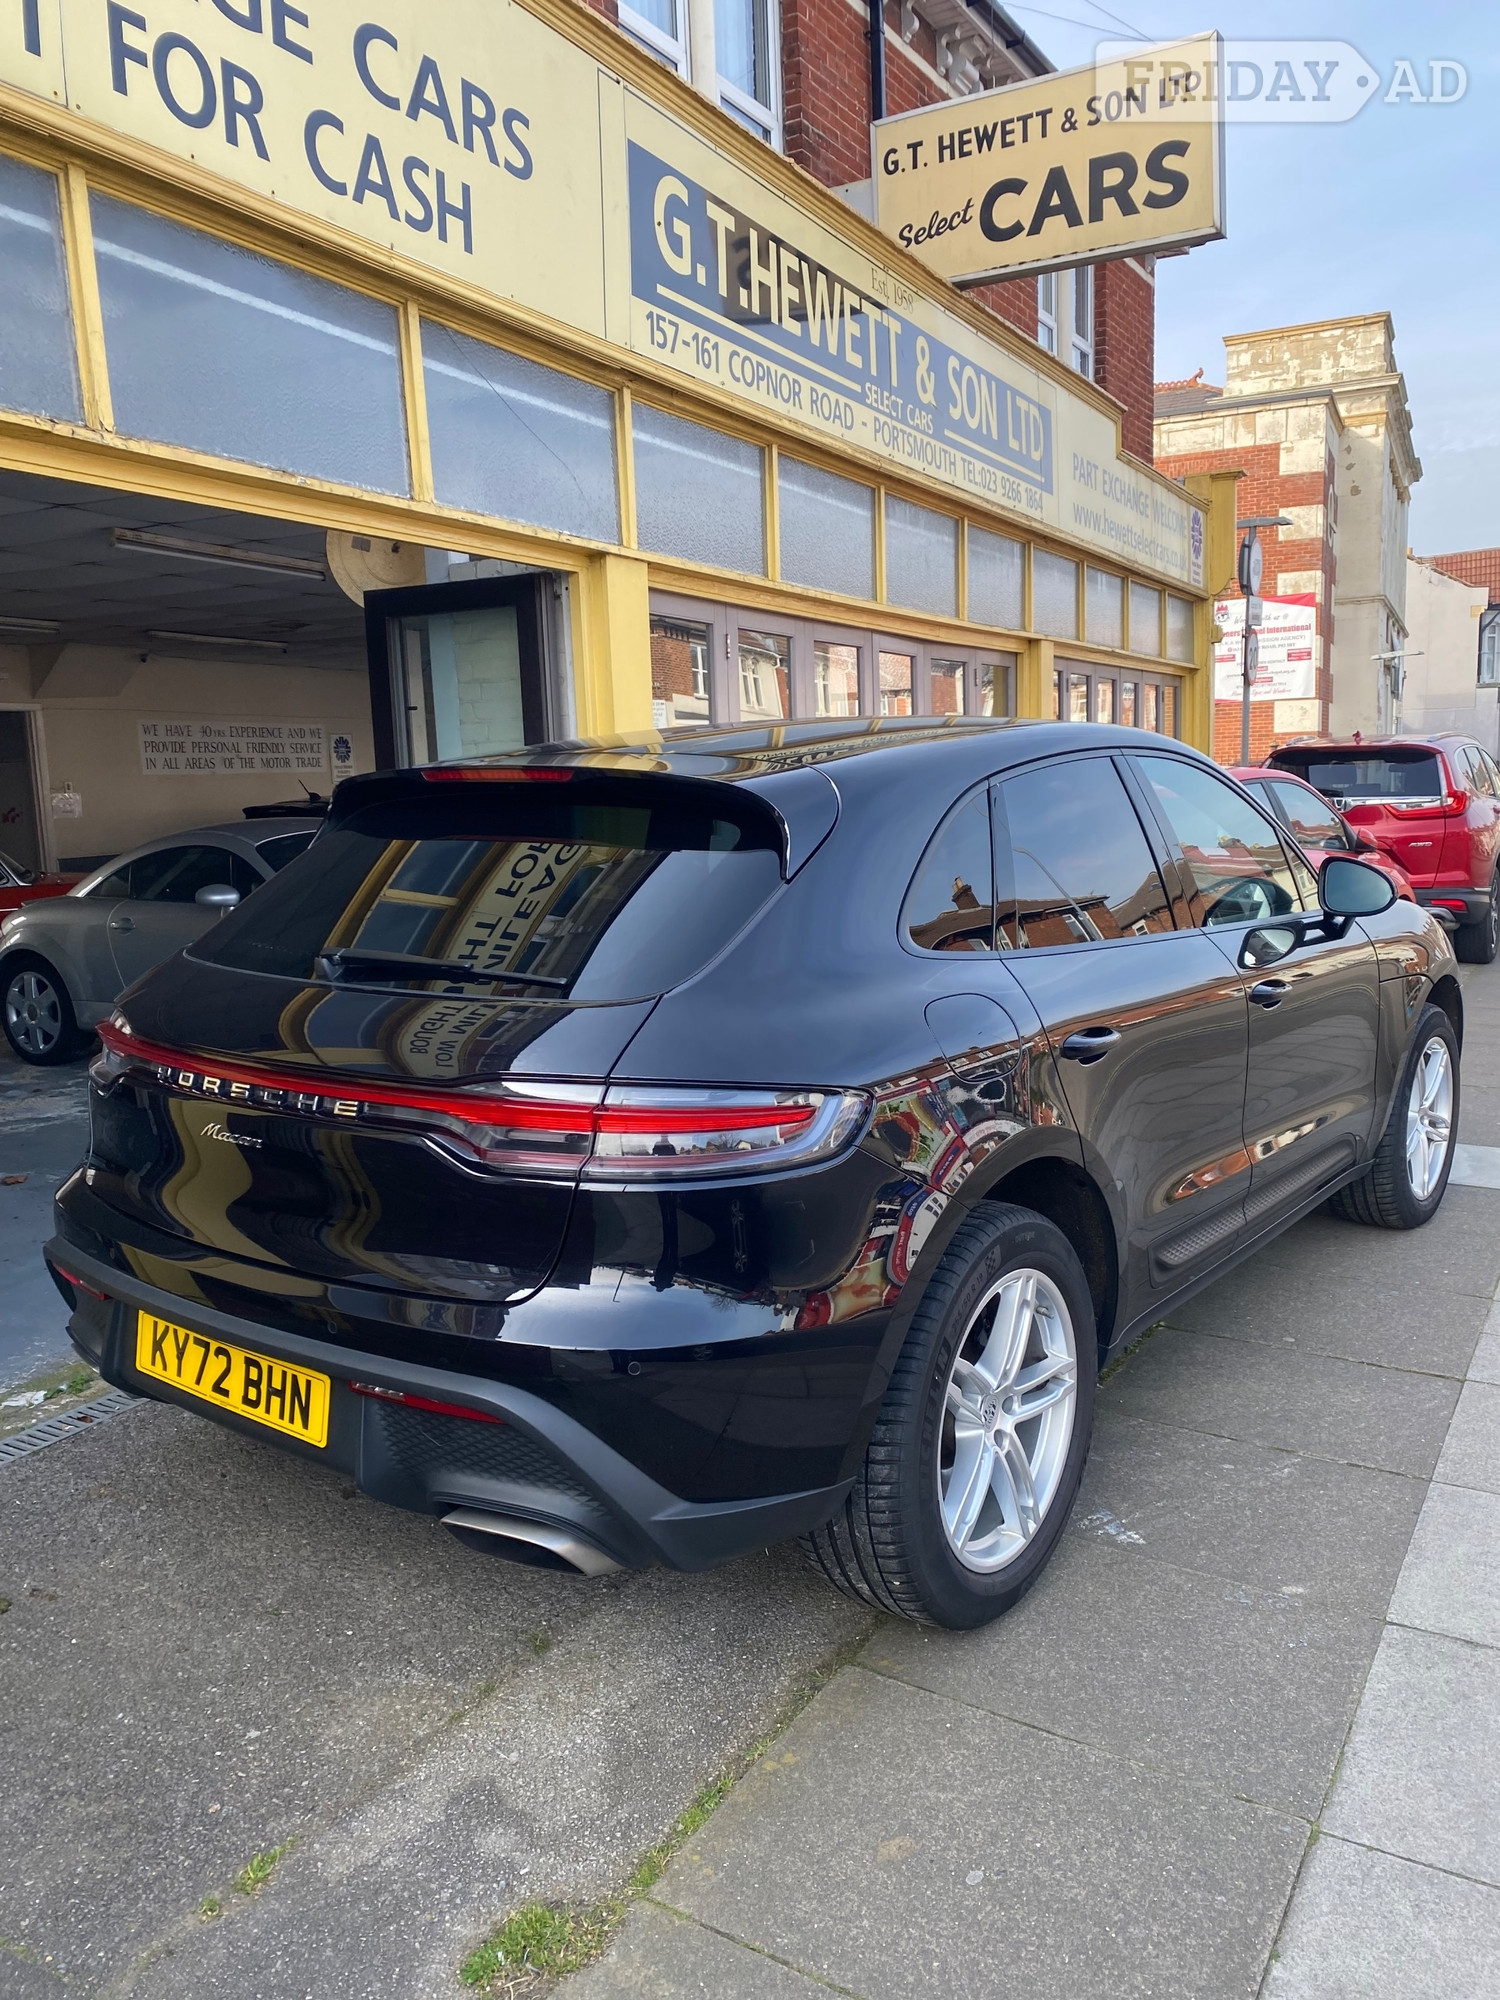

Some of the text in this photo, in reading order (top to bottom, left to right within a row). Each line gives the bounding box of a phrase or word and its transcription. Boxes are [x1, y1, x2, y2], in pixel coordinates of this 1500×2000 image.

[107, 0, 270, 162] FOR
[304, 109, 473, 255] CASH
[353, 23, 533, 181] CARS
[883, 138, 928, 176] G.T.
[938, 107, 1053, 163] HEWETT
[1061, 107, 1078, 133] &
[1086, 82, 1146, 126] SON
[898, 139, 1191, 248] Select CARS
[893, 282, 914, 315] 1958
[646, 310, 720, 374] 157-161
[728, 350, 803, 410] COPNOR
[810, 386, 854, 431] ROAD
[874, 415, 957, 477] PORTSMOUTH
[1001, 475, 1022, 504] 9266
[1025, 488, 1043, 513] 1864
[865, 382, 934, 435] SELECT CARS
[915, 335, 937, 409] &
[948, 355, 998, 440] SON
[1007, 390, 1044, 461] LTD
[1073, 452, 1187, 539] PART EXCHANGE WELCOME
[1073, 502, 1187, 571] www.hewettselectcars.co.uk
[1266, 624, 1311, 634] International
[142, 724, 159, 737] WE
[165, 724, 192, 737] HAVE
[229, 726, 283, 739] EXPERIENCE
[287, 727, 306, 739] AND
[309, 727, 322, 739] WE
[144, 741, 322, 754] PROVIDE PERSONAL FRIENDLY SERVICE
[145, 757, 322, 770] IN ALL AREAS OF THE MOTOR TRADE
[158, 1066, 358, 1117] PORSCHE
[200, 1122, 263, 1149] Macan
[151, 1319, 312, 1431] KY72 BHN
